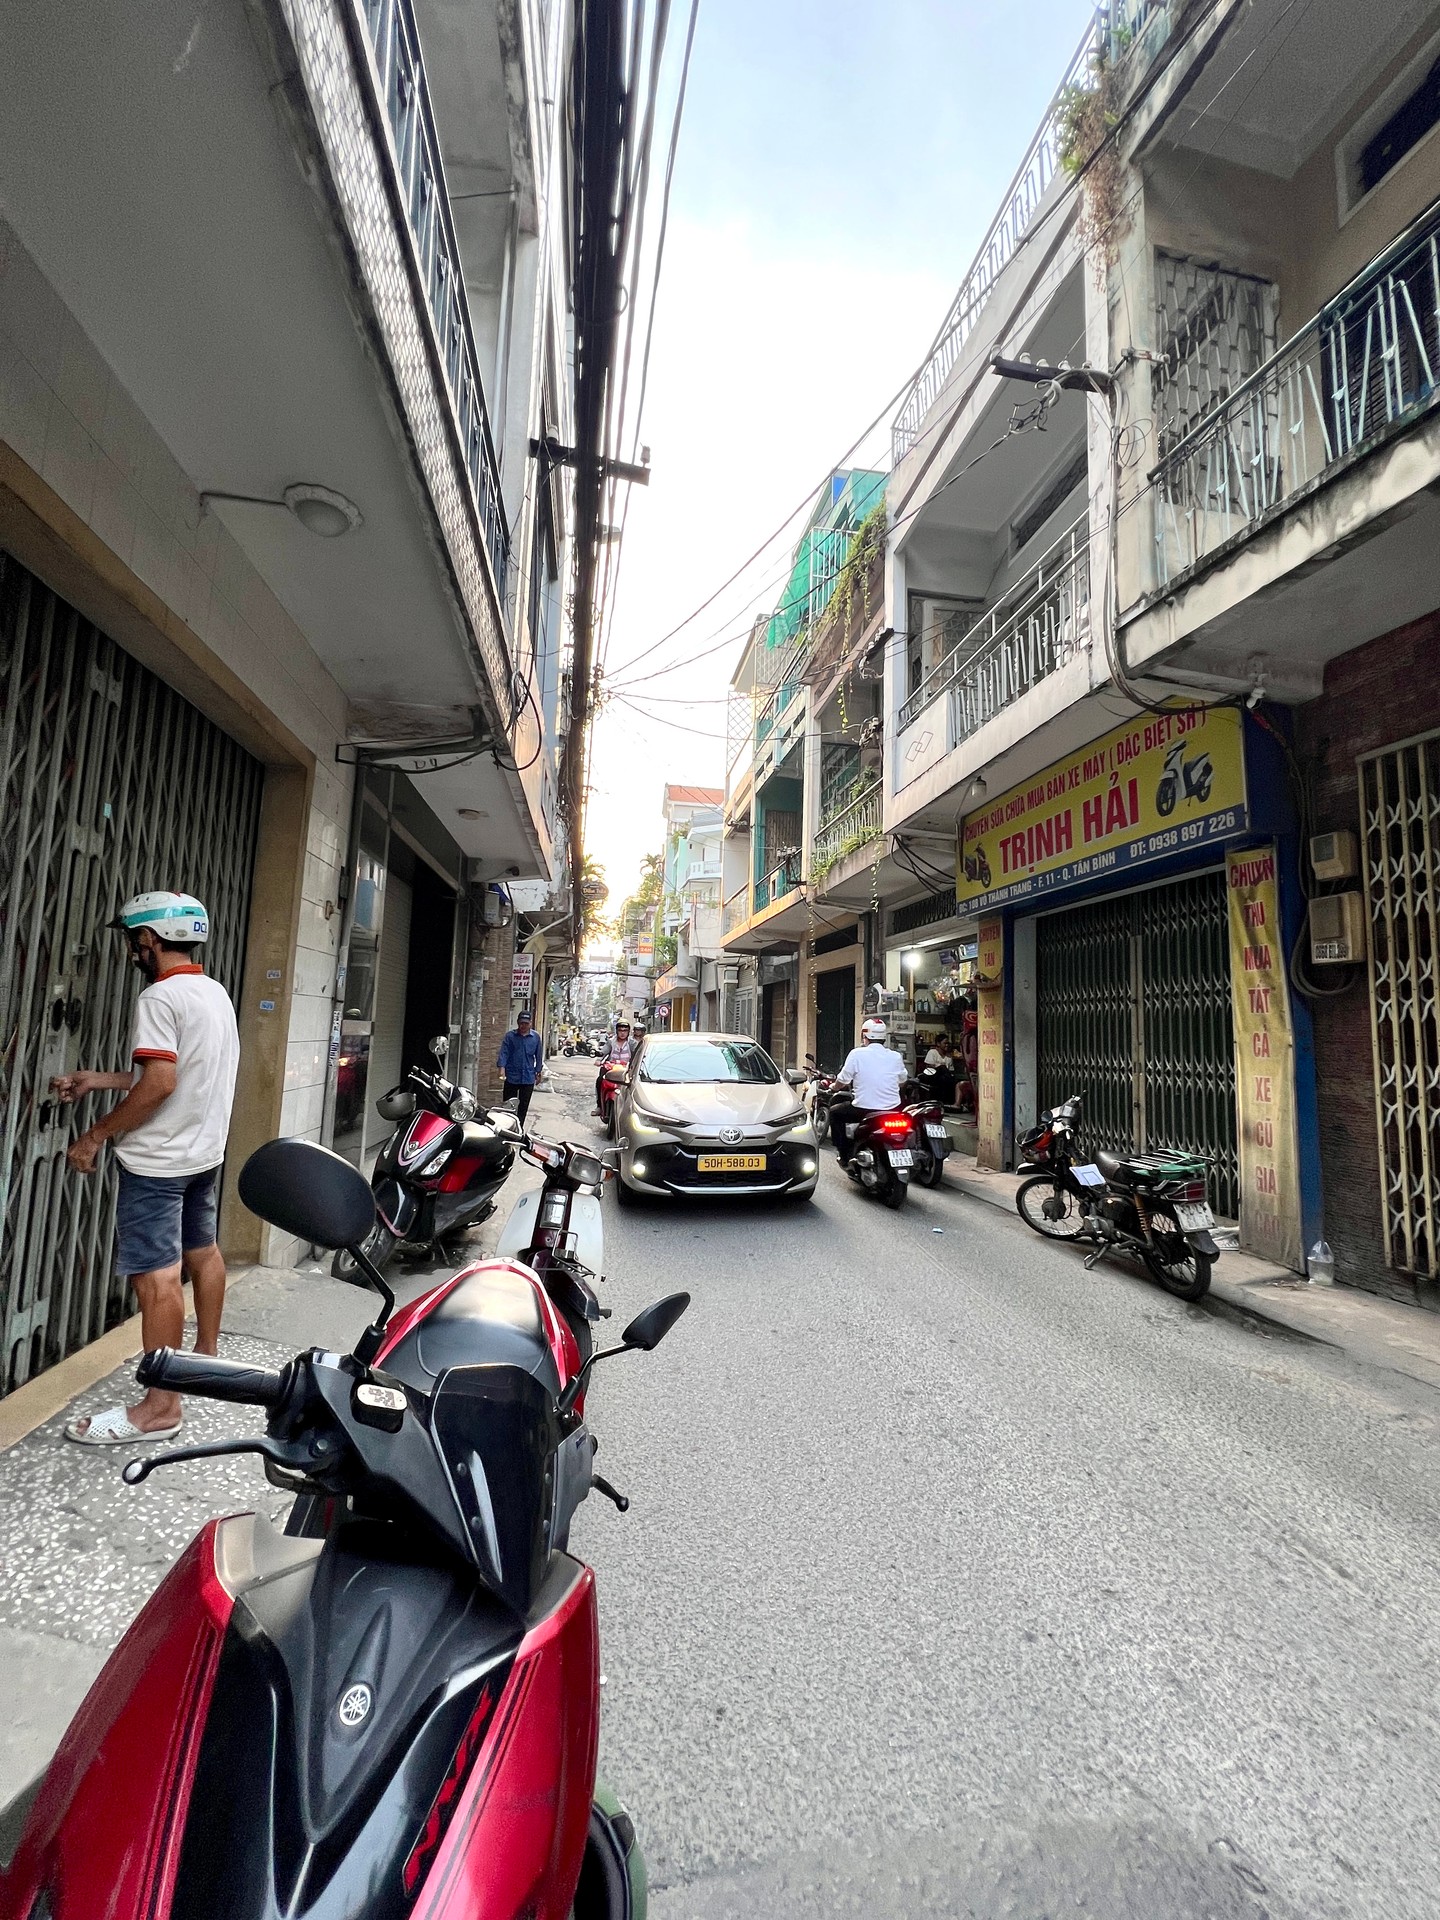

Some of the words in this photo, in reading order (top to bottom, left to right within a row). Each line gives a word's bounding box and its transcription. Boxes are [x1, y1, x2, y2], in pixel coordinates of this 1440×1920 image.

[1027, 785, 1045, 811] MUA
[1047, 773, 1066, 801] BÁN
[1068, 769, 1081, 791] XE
[1083, 748, 1105, 782] MÁY
[999, 808, 1073, 874] TRỊNH
[1082, 770, 1140, 843] HẢI
[1129, 842, 1147, 858] ĐT:
[1149, 830, 1178, 852] 0938
[1181, 821, 1205, 842] 897
[1209, 811, 1236, 834] 226
[1009, 880, 1032, 897] TRANG
[1046, 873, 1055, 886] 11
[1062, 867, 1072, 881] Q.
[1073, 859, 1090, 877] TÂN
[1092, 850, 1116, 871] BÌNH
[1243, 944, 1272, 971] MUA
[1252, 1023, 1271, 1058] CẢ
[1254, 1076, 1272, 1103] XE
[1255, 1117, 1273, 1148] CŨ
[704, 1157, 760, 1168] 50H-588.03
[1255, 1162, 1278, 1196] GIÁ
